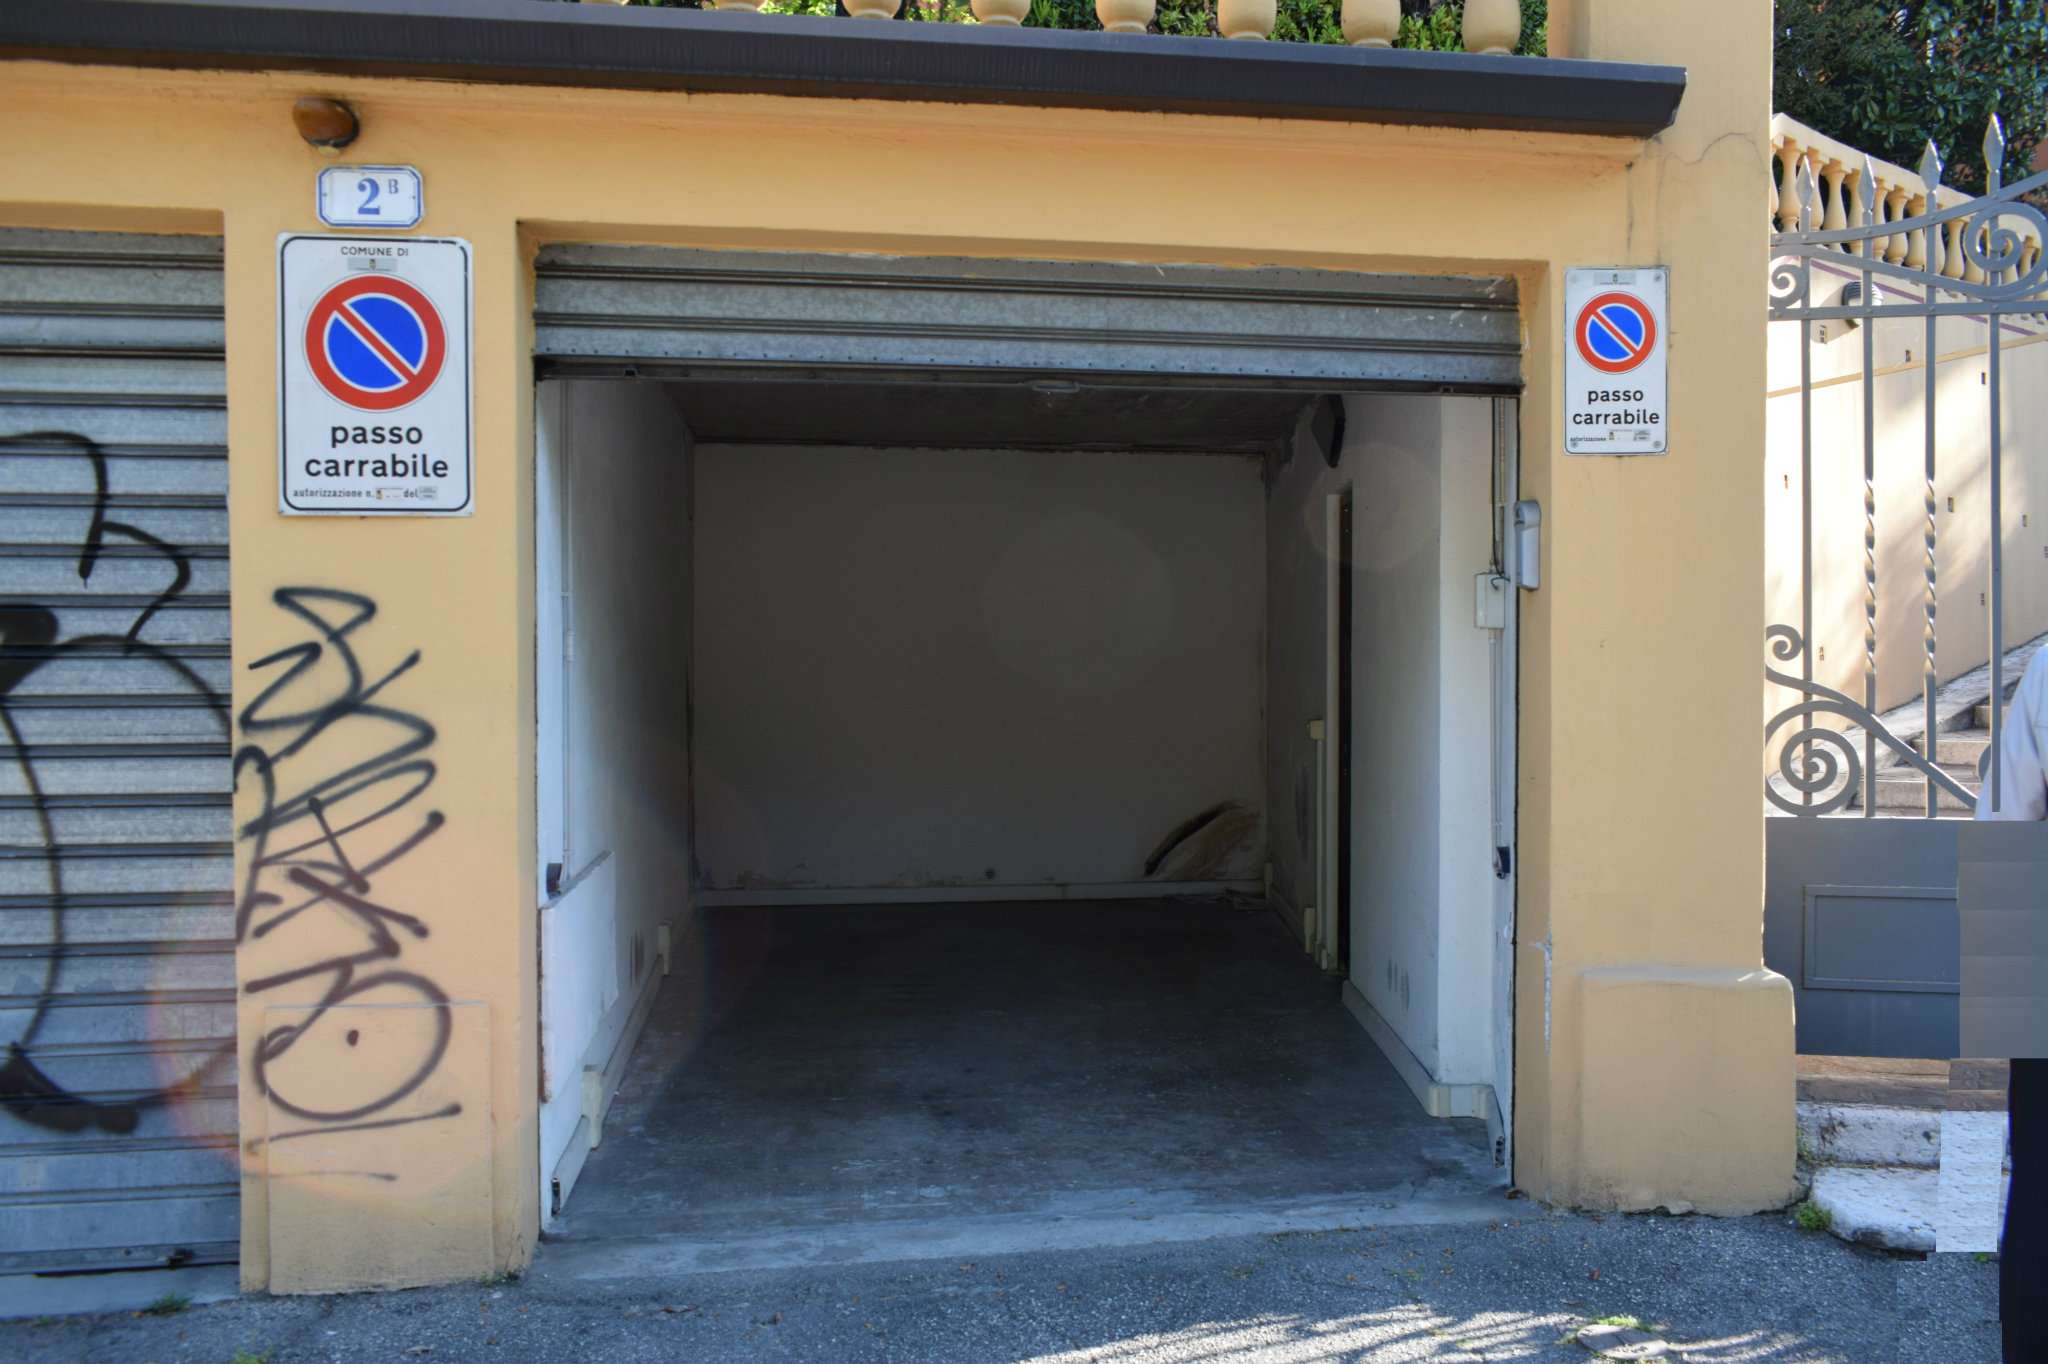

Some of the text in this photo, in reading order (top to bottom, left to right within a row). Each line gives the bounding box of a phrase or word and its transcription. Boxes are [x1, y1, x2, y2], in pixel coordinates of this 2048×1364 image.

[340, 246, 409, 257] COMUNE DI
[1587, 389, 1644, 405] passo
[1572, 408, 1660, 425] carrabile
[331, 425, 423, 448] passo
[304, 453, 449, 478] carrabile
[292, 487, 362, 498] autorizzazione
[403, 488, 419, 499] del
